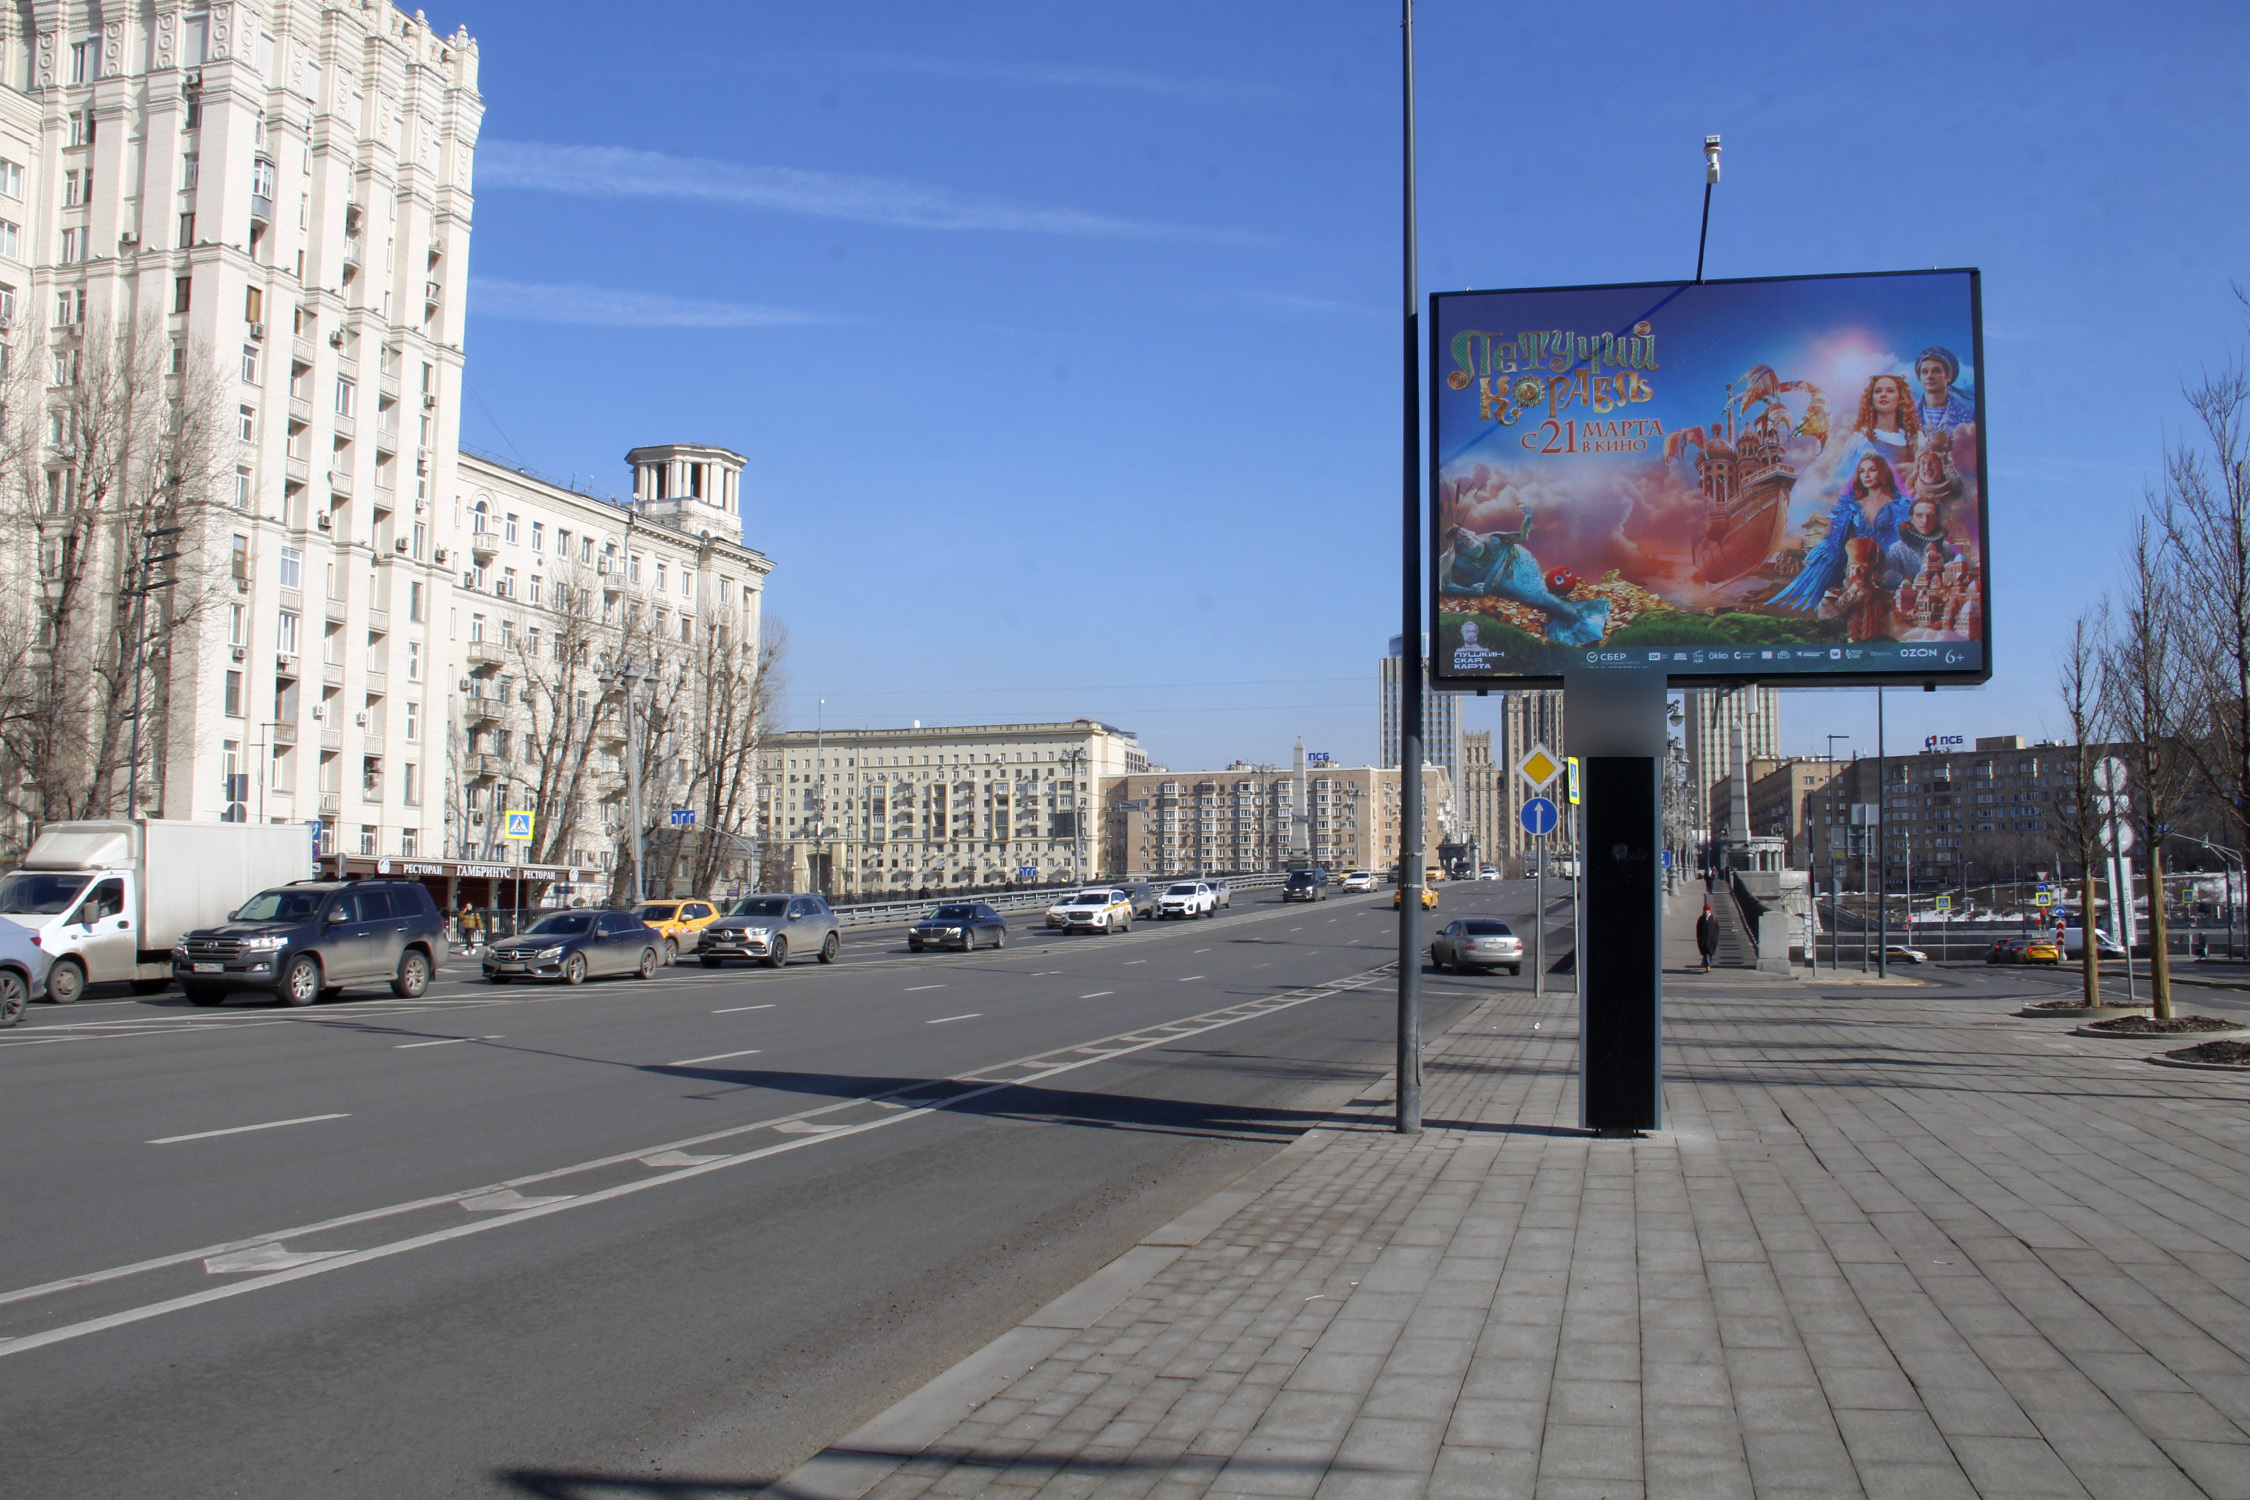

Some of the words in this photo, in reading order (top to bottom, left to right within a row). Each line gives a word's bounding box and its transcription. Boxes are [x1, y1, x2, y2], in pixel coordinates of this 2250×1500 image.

[1540, 420, 1578, 454] 21
[1582, 419, 1665, 438] МАРТА
[1582, 440, 1591, 453] В
[1595, 439, 1647, 452] КИНО
[1600, 652, 1627, 661] СБЕР
[1900, 648, 1938, 658] OZON
[1945, 650, 1965, 664] 6+
[1940, 735, 1963, 745] ПСБ
[1308, 752, 1330, 761] ПСБ
[403, 863, 443, 875] РЕСТОРАН
[456, 865, 511, 879] ГАМБРИНУС
[523, 870, 556, 880] РЕСТОРАН
